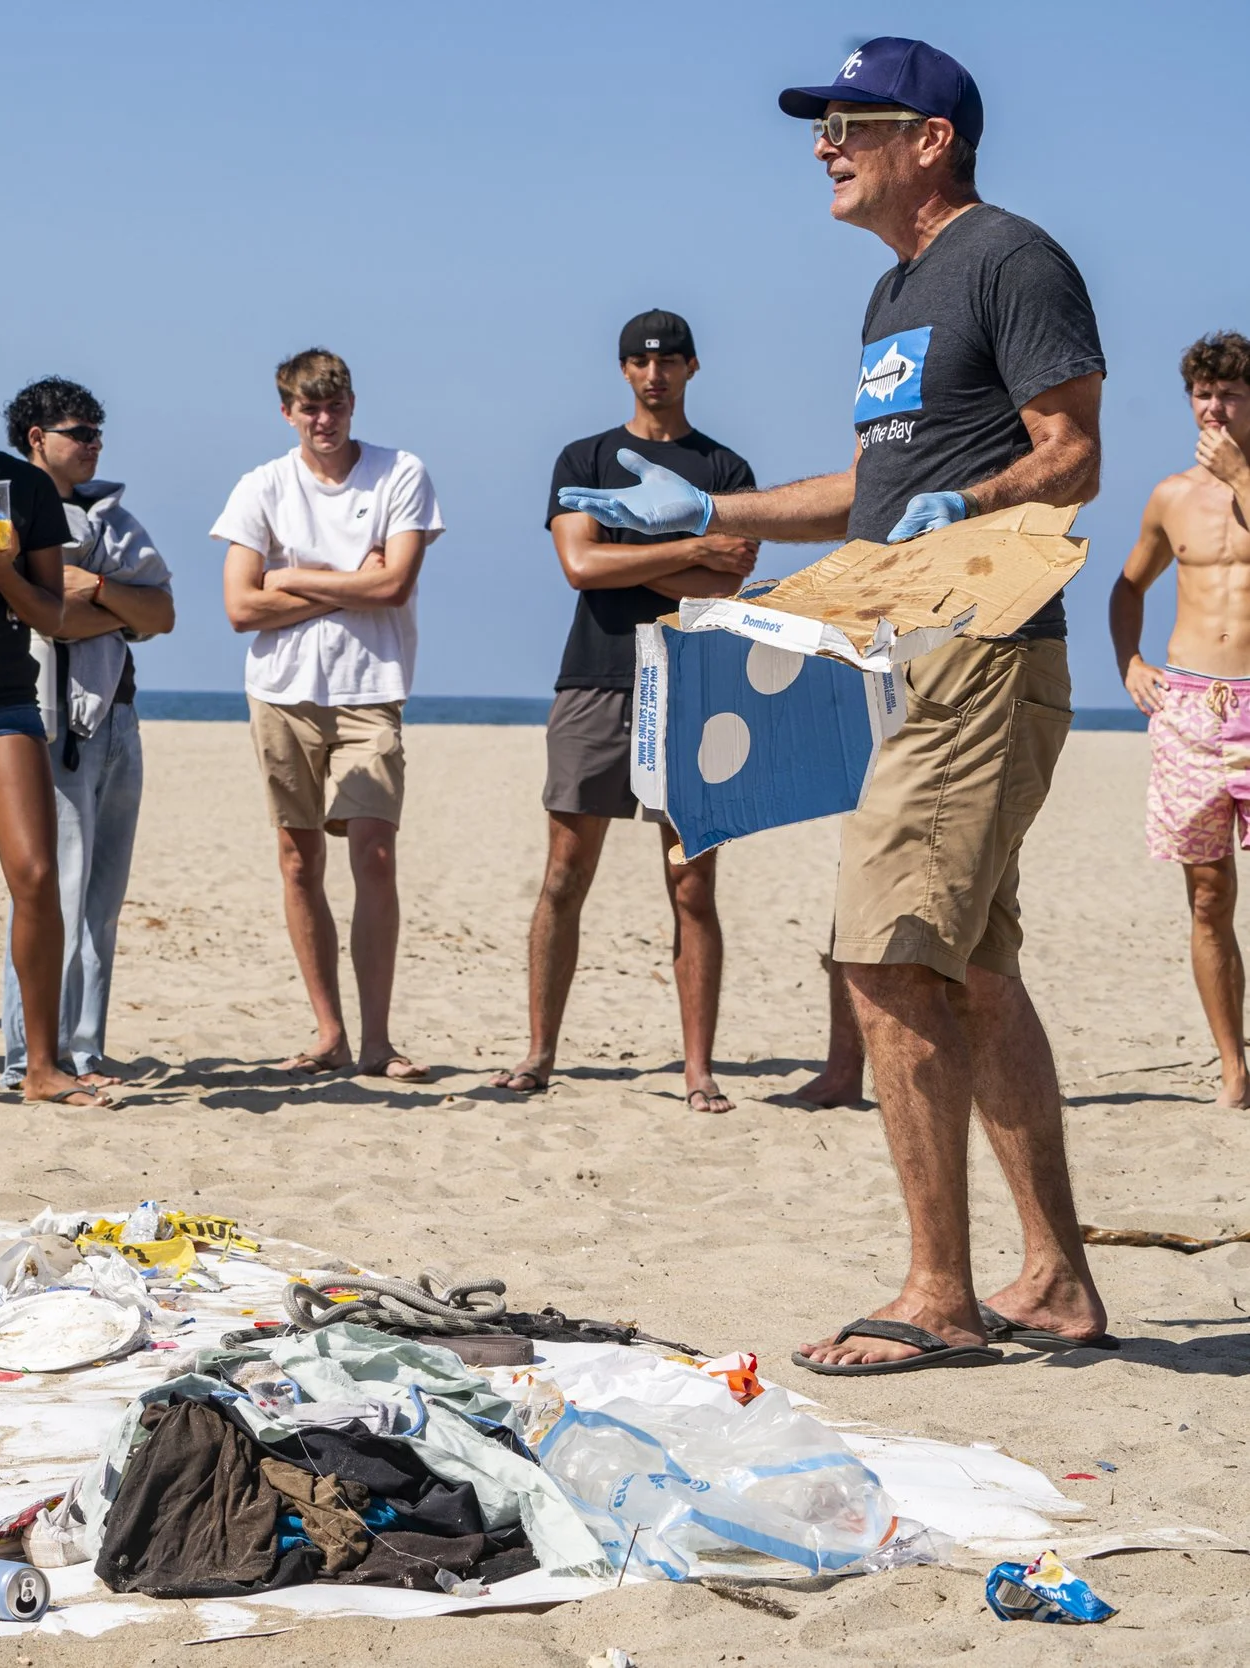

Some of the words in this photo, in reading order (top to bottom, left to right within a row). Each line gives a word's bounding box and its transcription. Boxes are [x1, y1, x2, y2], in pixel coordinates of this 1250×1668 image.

[887, 419, 915, 443] Bay
[742, 614, 783, 633] Domino's
[639, 667, 650, 706] WITHOUT
[650, 665, 658, 683] YOU
[649, 684, 658, 710] CAN'T
[638, 707, 648, 739] SAYING
[648, 711, 657, 730] SAY
[646, 731, 656, 772] DOMINO'S
